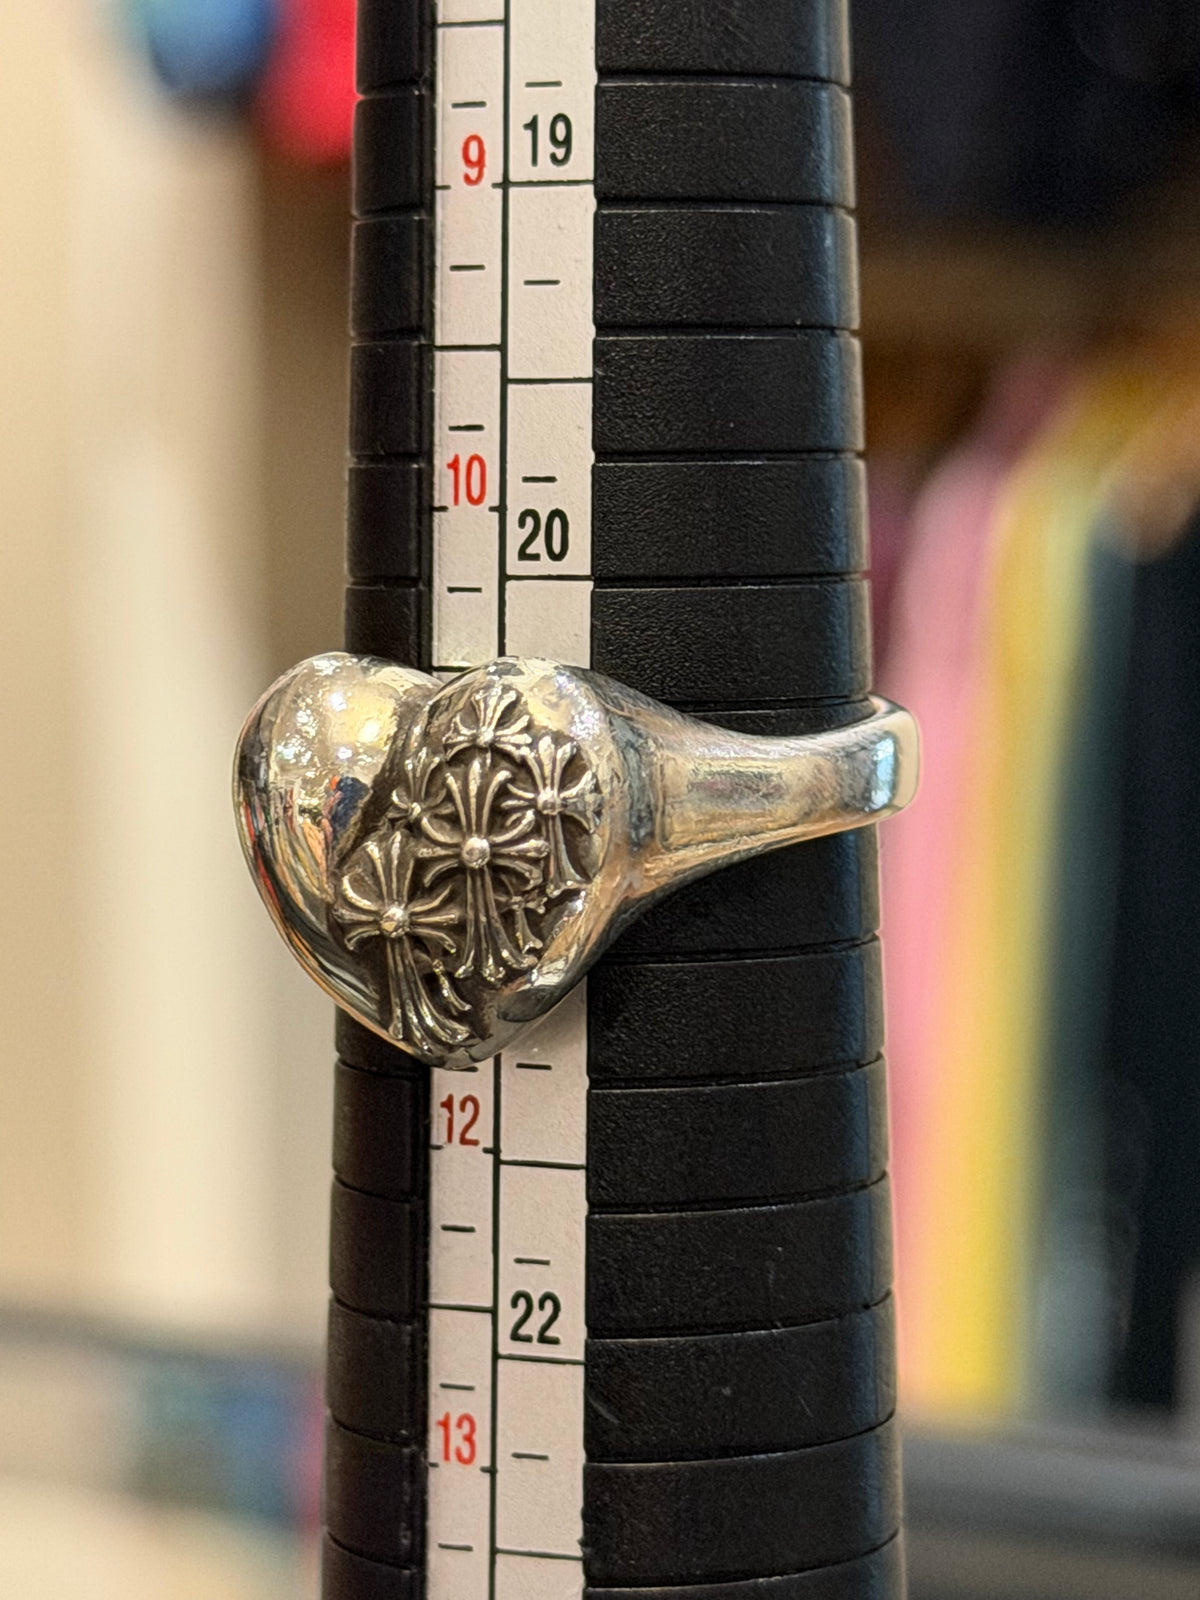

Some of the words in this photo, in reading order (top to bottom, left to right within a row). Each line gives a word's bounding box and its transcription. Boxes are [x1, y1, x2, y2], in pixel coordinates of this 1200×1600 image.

[461, 134, 486, 186] 9
[522, 113, 573, 167] 19
[446, 453, 487, 506] 10
[518, 508, 569, 562] 20
[440, 1093, 480, 1146] 12
[510, 1290, 562, 1345] 22
[435, 1412, 477, 1466] 13
